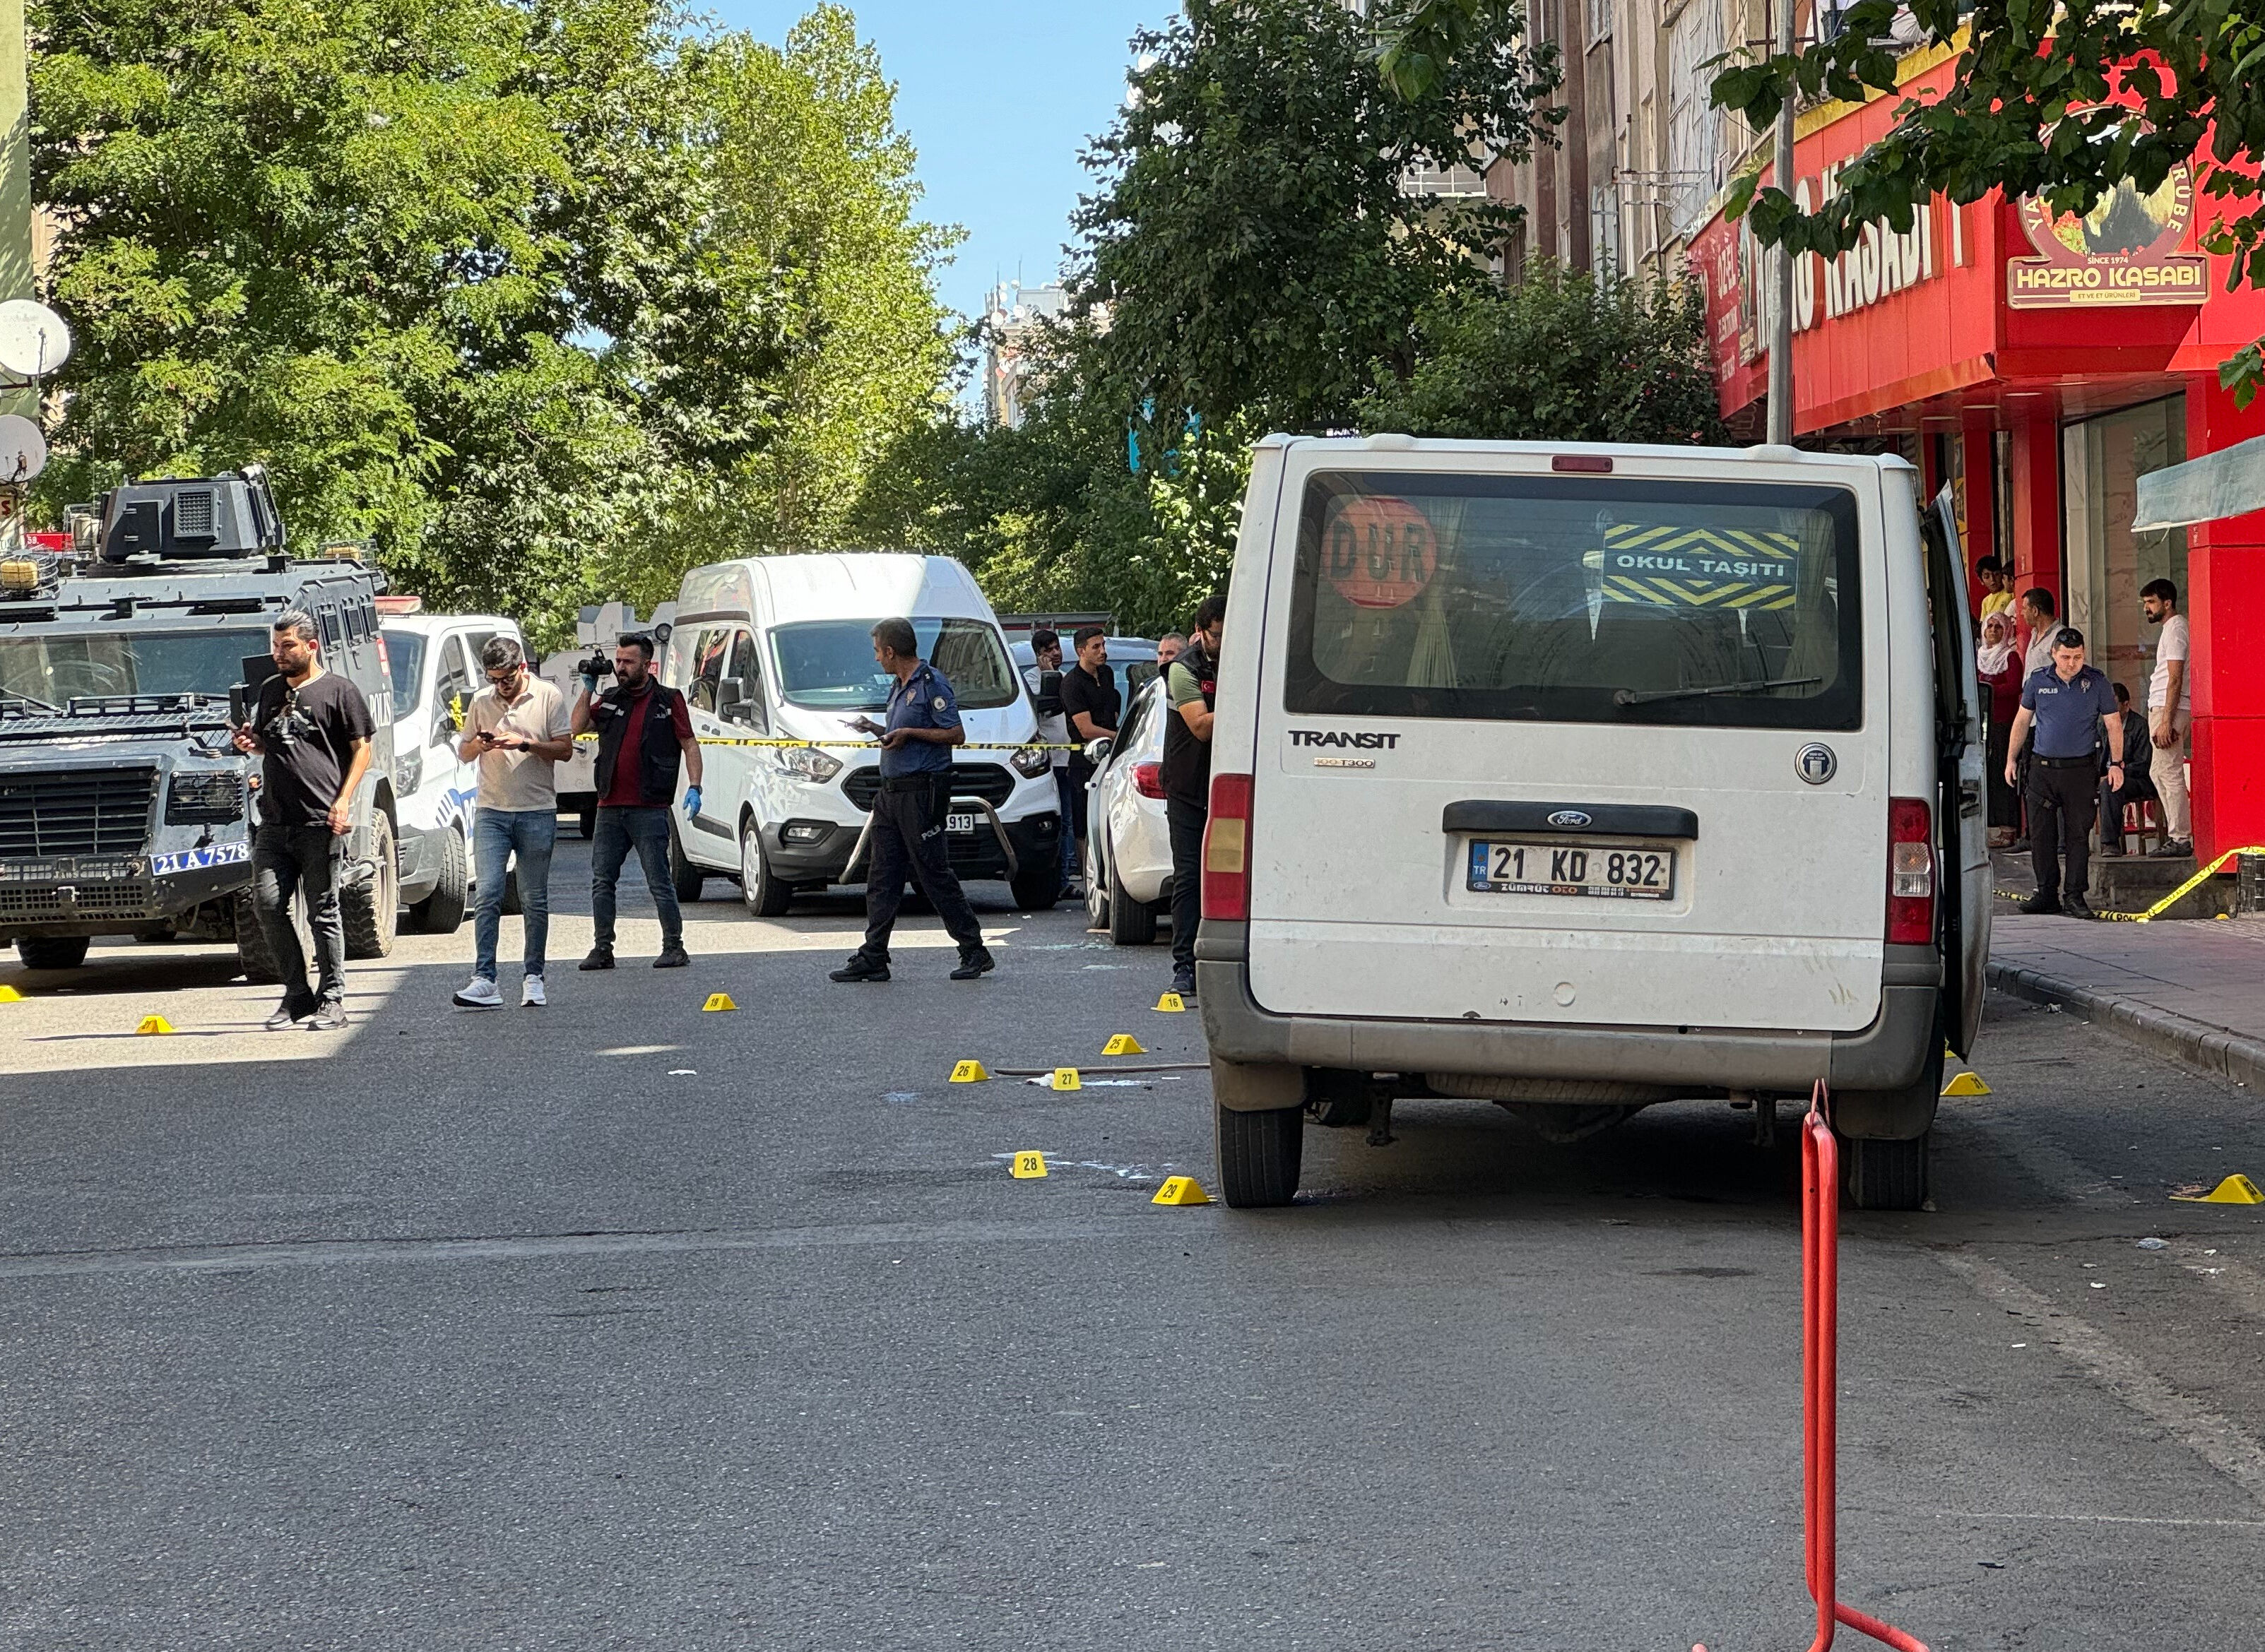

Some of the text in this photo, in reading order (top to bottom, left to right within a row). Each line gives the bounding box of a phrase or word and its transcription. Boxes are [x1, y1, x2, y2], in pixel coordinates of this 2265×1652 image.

[2017, 266, 2201, 288] HAZRO KASABI
[1330, 521, 1426, 581] DUR
[1616, 555, 1784, 577] OKUL TAŞITI
[1288, 730, 1401, 749] TRANSIT
[949, 816, 971, 829] 913
[1556, 813, 1584, 826] Ford
[157, 843, 249, 872] 21 A 7578
[1473, 865, 1486, 875] TR
[1494, 848, 1660, 886] 21 KD 832
[1168, 998, 1178, 1007] 16
[1109, 1038, 1121, 1049] 25
[957, 1065, 970, 1076] 26
[1062, 1074, 1072, 1085] 27
[1023, 1158, 1037, 1171] 28
[1162, 1183, 1178, 1199] 29
